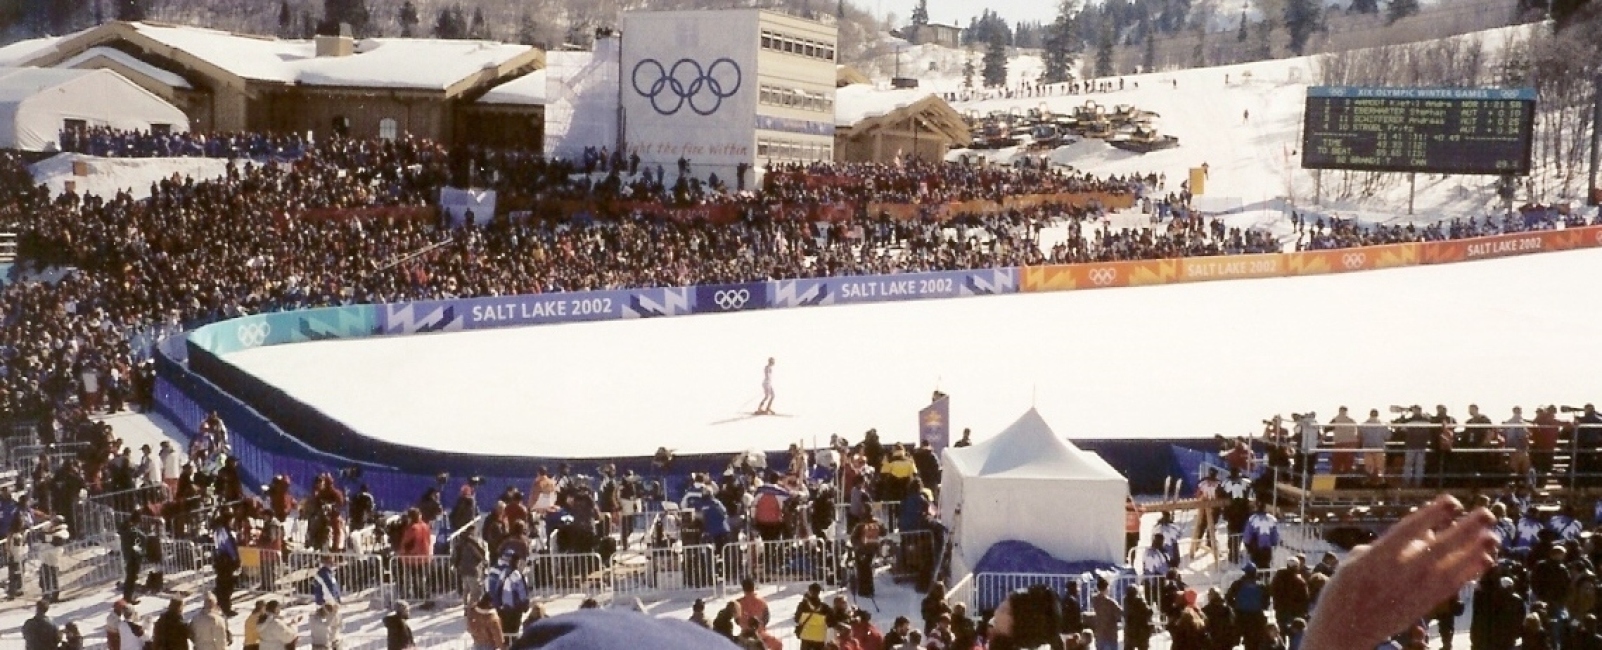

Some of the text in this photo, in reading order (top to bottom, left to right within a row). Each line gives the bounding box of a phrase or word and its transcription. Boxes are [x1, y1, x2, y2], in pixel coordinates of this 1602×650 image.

[1358, 89, 1488, 98] XIX OLYMPIC WINTER GAMES
[1461, 109, 1477, 117] AUT
[657, 142, 679, 155] the
[681, 142, 704, 155] fire
[708, 142, 747, 156] within
[1322, 138, 1342, 147] TIME
[1317, 146, 1328, 154] TO
[1331, 147, 1352, 156] BEAT
[1467, 237, 1541, 257] SALT LAKE 2002
[1188, 259, 1277, 277] SALT LAKE 2002
[841, 278, 953, 298] SALT LAKE 2002
[472, 297, 613, 322] SALT LAKE 2002
